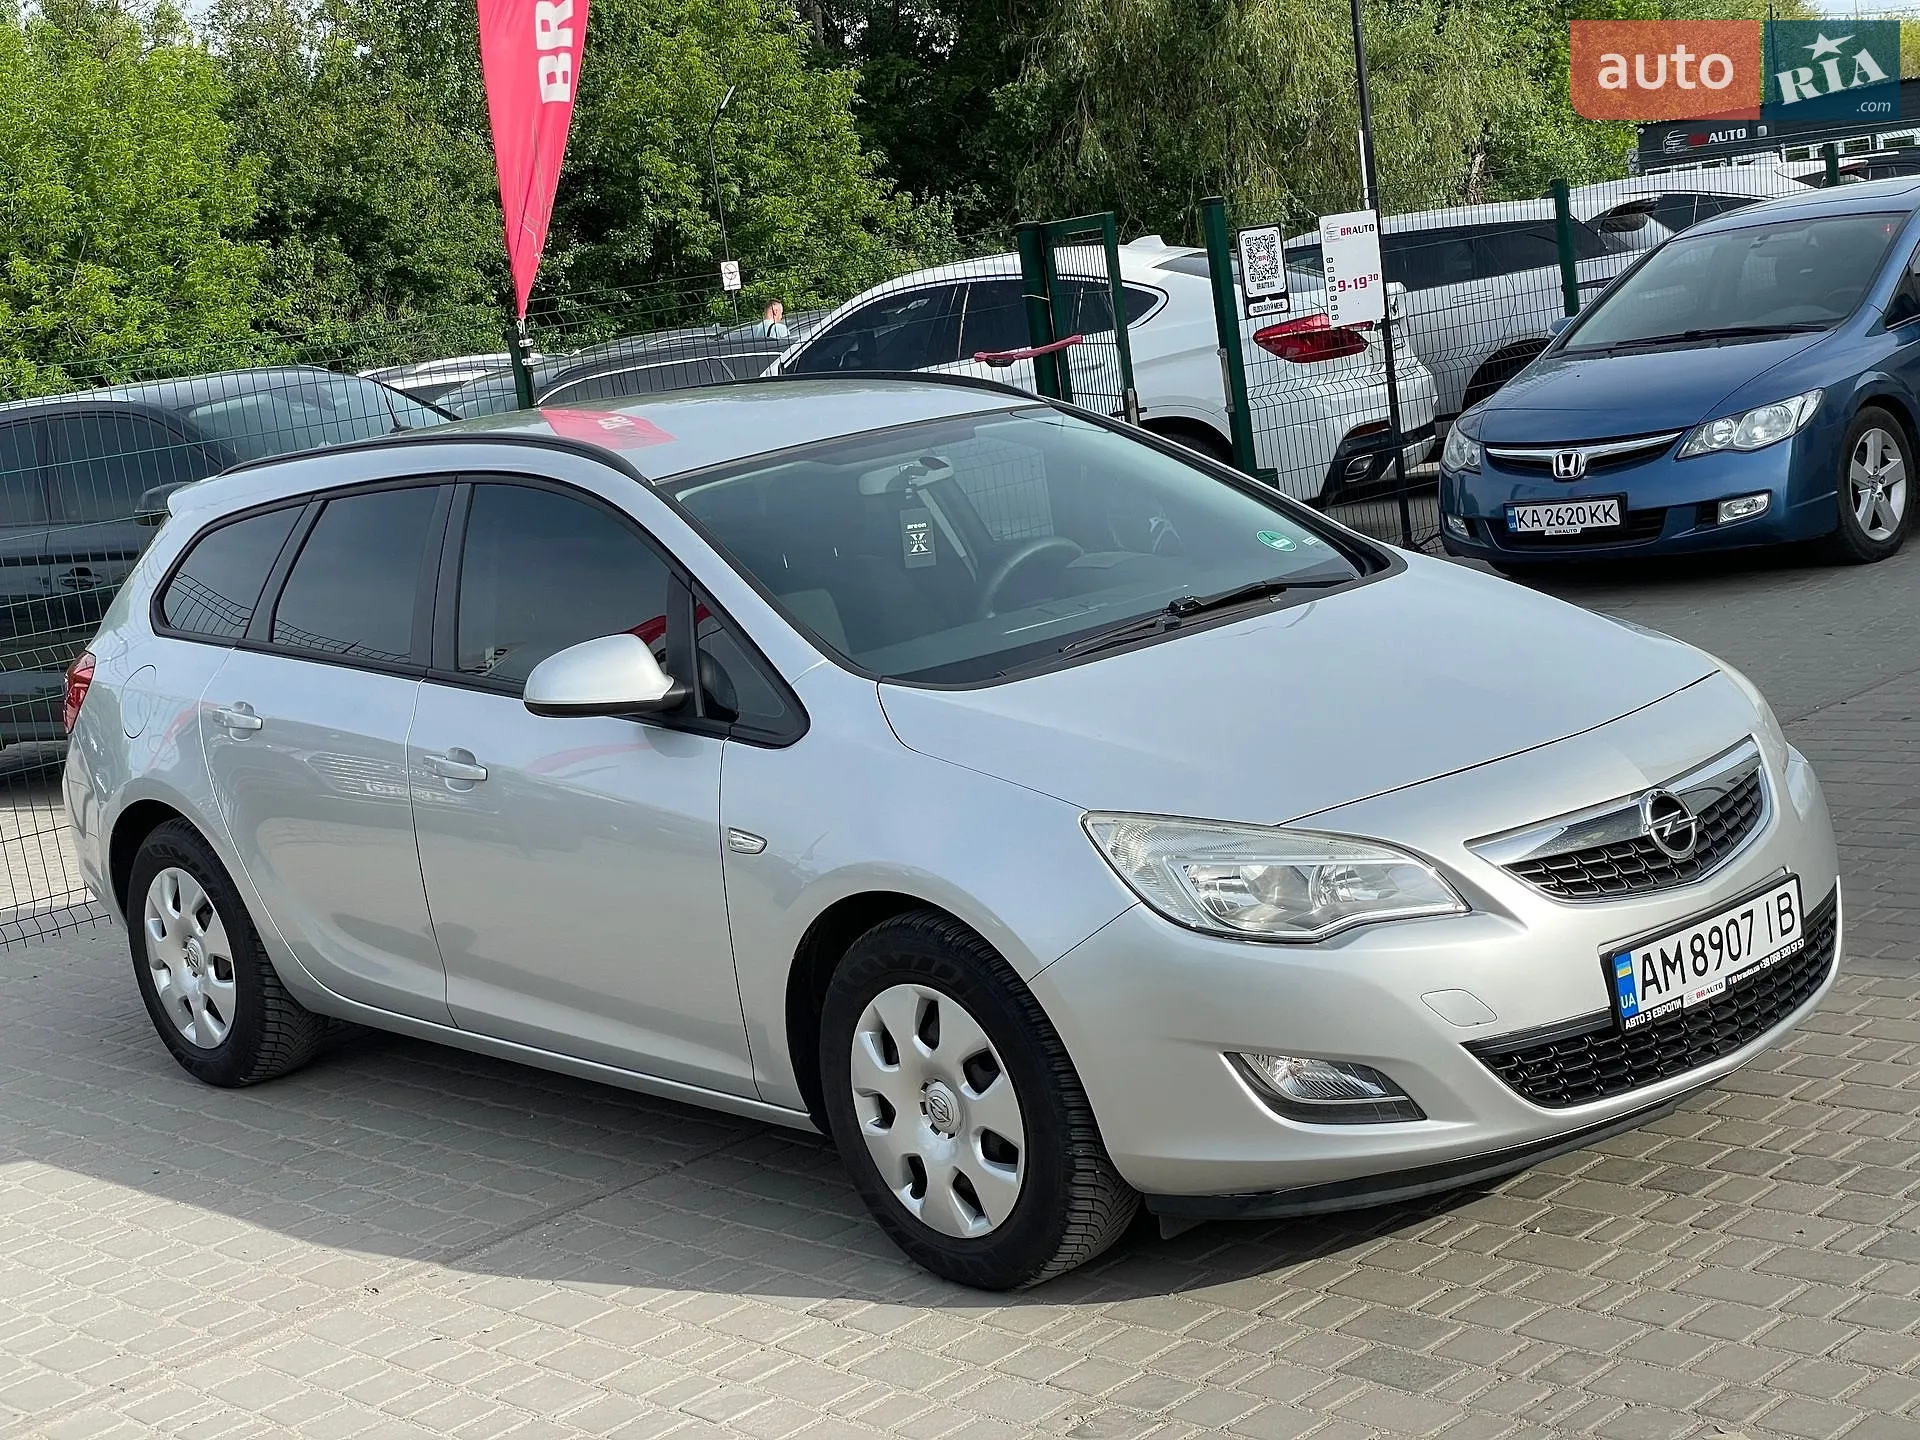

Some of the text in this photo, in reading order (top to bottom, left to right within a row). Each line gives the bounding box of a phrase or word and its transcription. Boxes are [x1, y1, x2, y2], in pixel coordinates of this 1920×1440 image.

[1688, 127, 1747, 146] AUTO
[1340, 223, 1375, 236] BRAUTO
[1516, 503, 1618, 529] KA 2620 KK
[1641, 891, 1796, 1002] AM 8907 IB
[1695, 982, 1725, 999] BRAUTO
[1620, 992, 1637, 1009] UA
[1625, 1013, 1646, 1030] АВТО
